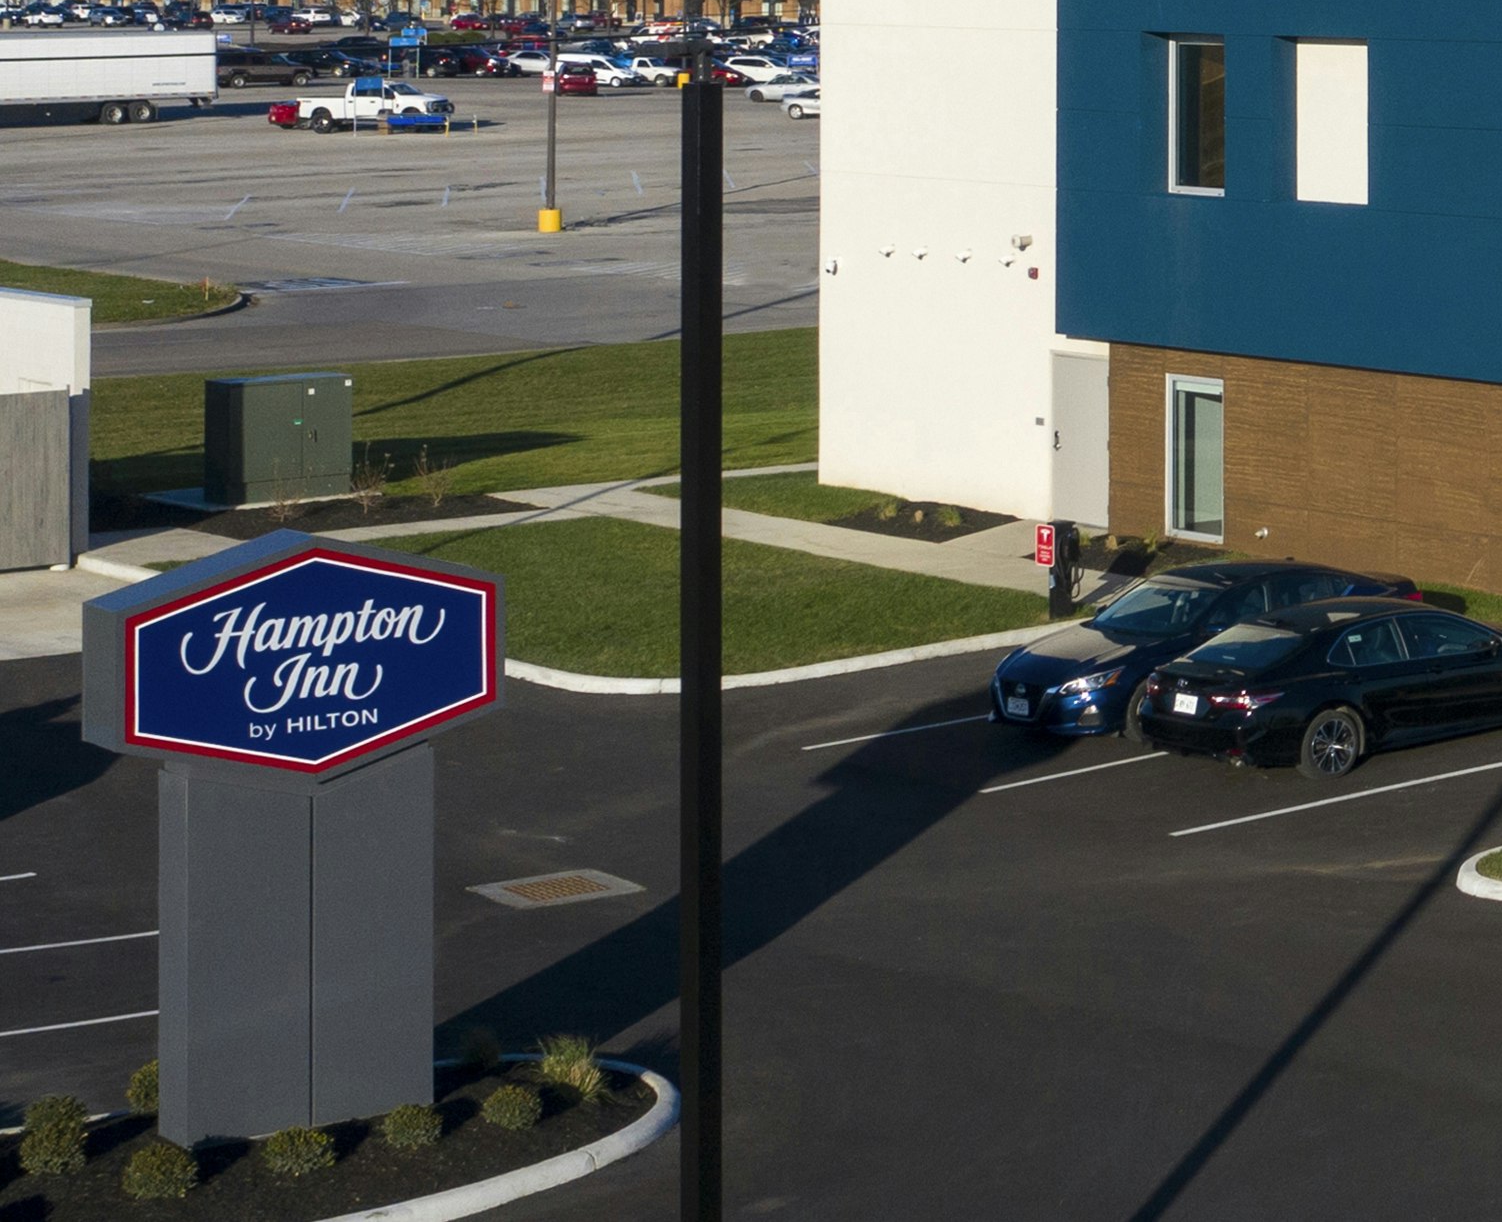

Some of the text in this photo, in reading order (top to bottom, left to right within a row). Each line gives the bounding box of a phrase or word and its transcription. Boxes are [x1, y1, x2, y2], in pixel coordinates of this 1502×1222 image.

[180, 598, 446, 676] Hampton
[244, 652, 383, 714] Inn
[249, 708, 379, 741] by HILTON
